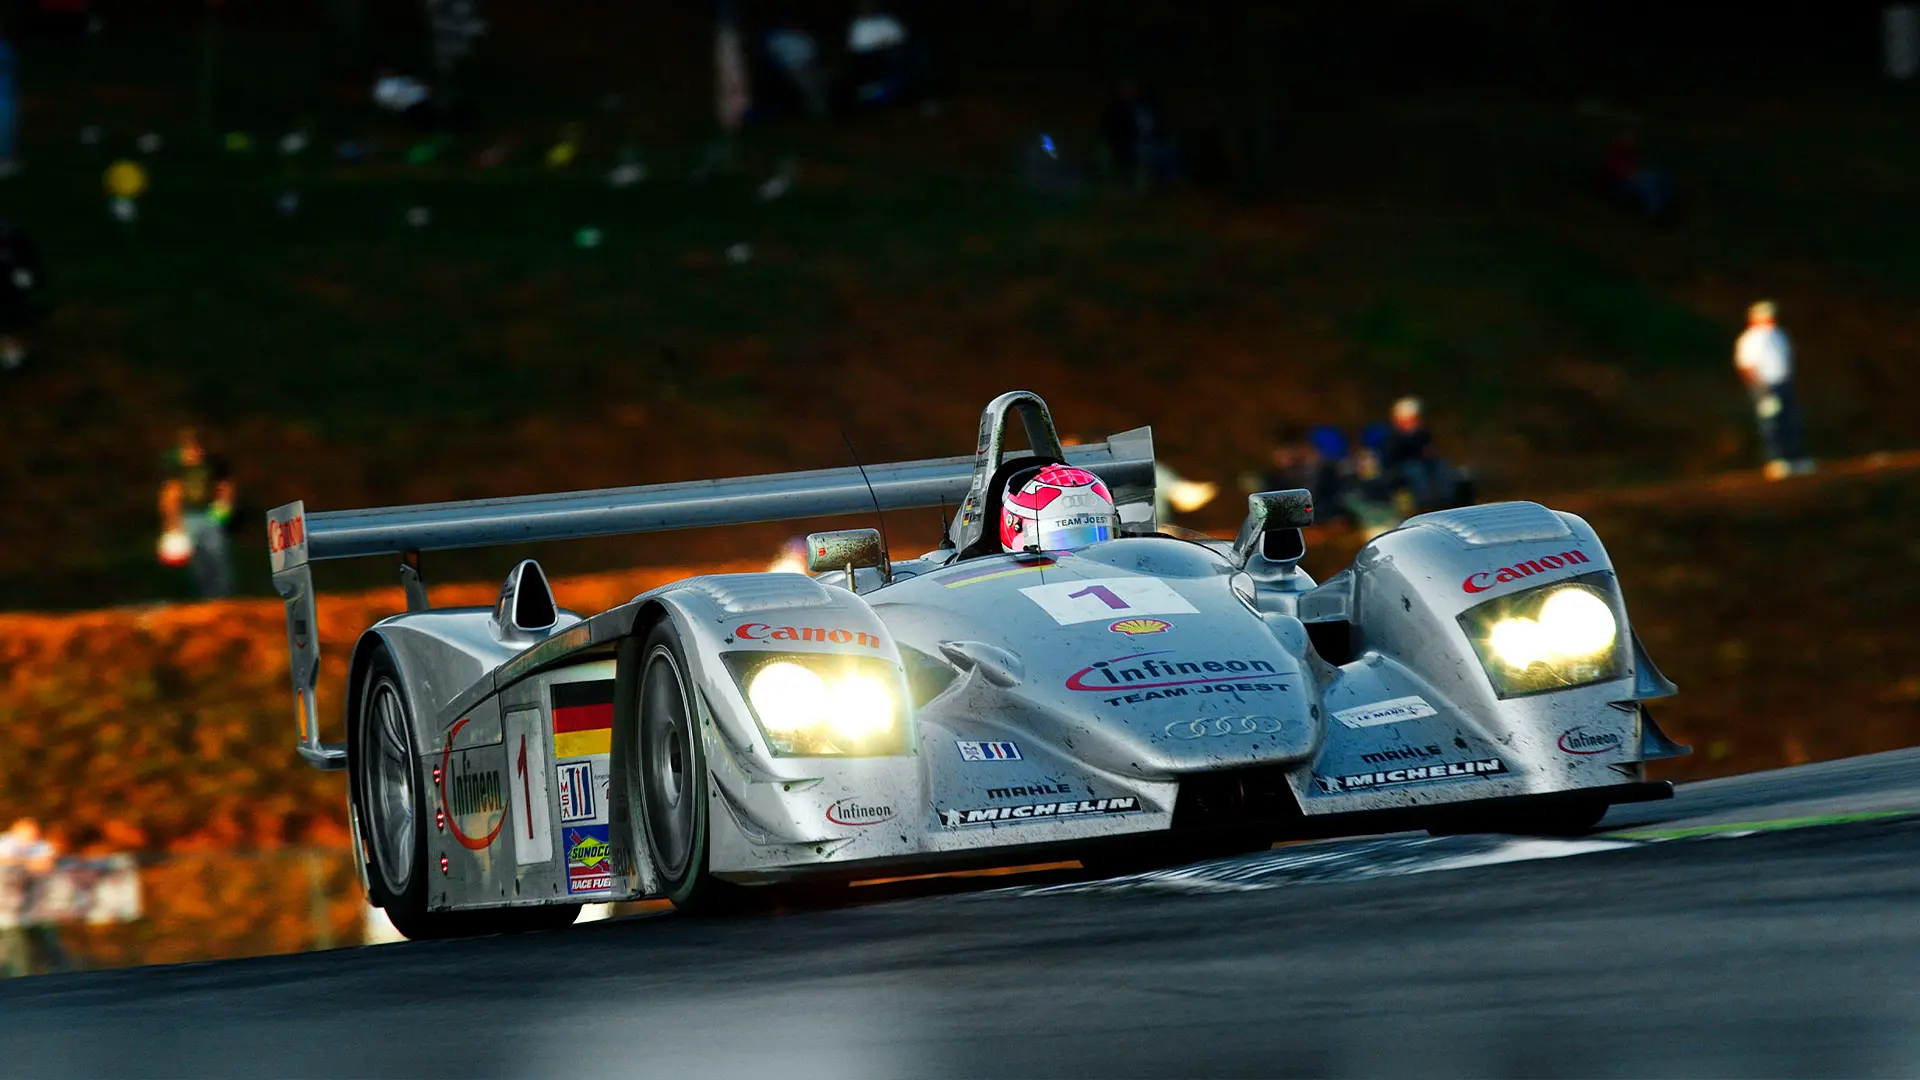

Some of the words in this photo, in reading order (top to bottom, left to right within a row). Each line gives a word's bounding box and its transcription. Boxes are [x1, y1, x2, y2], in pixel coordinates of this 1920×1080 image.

[1055, 518, 1082, 527] TEAM
[1084, 516, 1109, 525] JOEST
[1463, 550, 1590, 593] Canon
[1068, 585, 1131, 610] 1
[735, 623, 880, 649] Canon
[1104, 687, 1189, 707] TEAM
[1197, 683, 1291, 694] JOEST
[1361, 743, 1442, 764] MAHLE
[1345, 759, 1499, 787] MICHELIN
[517, 734, 534, 840] 1
[987, 783, 1071, 799] MAHLE
[967, 797, 1134, 822] MICHELIN
[571, 880, 592, 889] RACE
